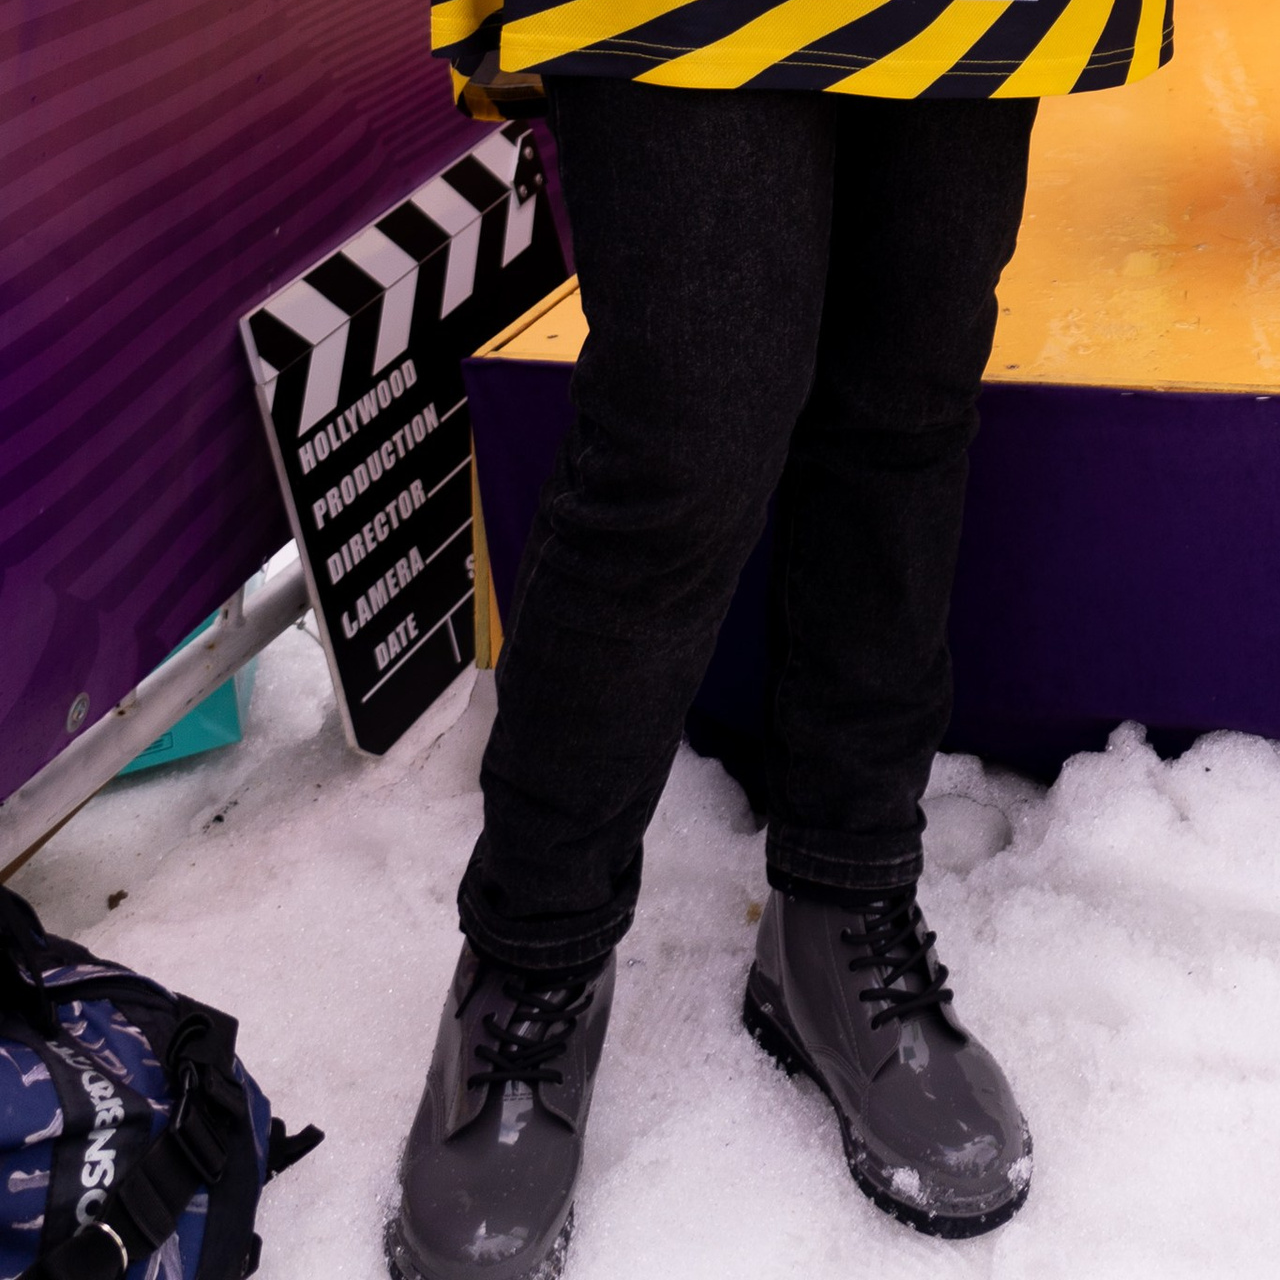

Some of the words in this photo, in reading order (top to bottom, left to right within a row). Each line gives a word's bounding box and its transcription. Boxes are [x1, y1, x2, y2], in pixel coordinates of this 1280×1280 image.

[297, 358, 419, 475] HOLLYWOOD
[312, 402, 440, 531] PRODUCTION
[326, 478, 427, 586] DIRECTOR
[373, 612, 420, 671] DATE
